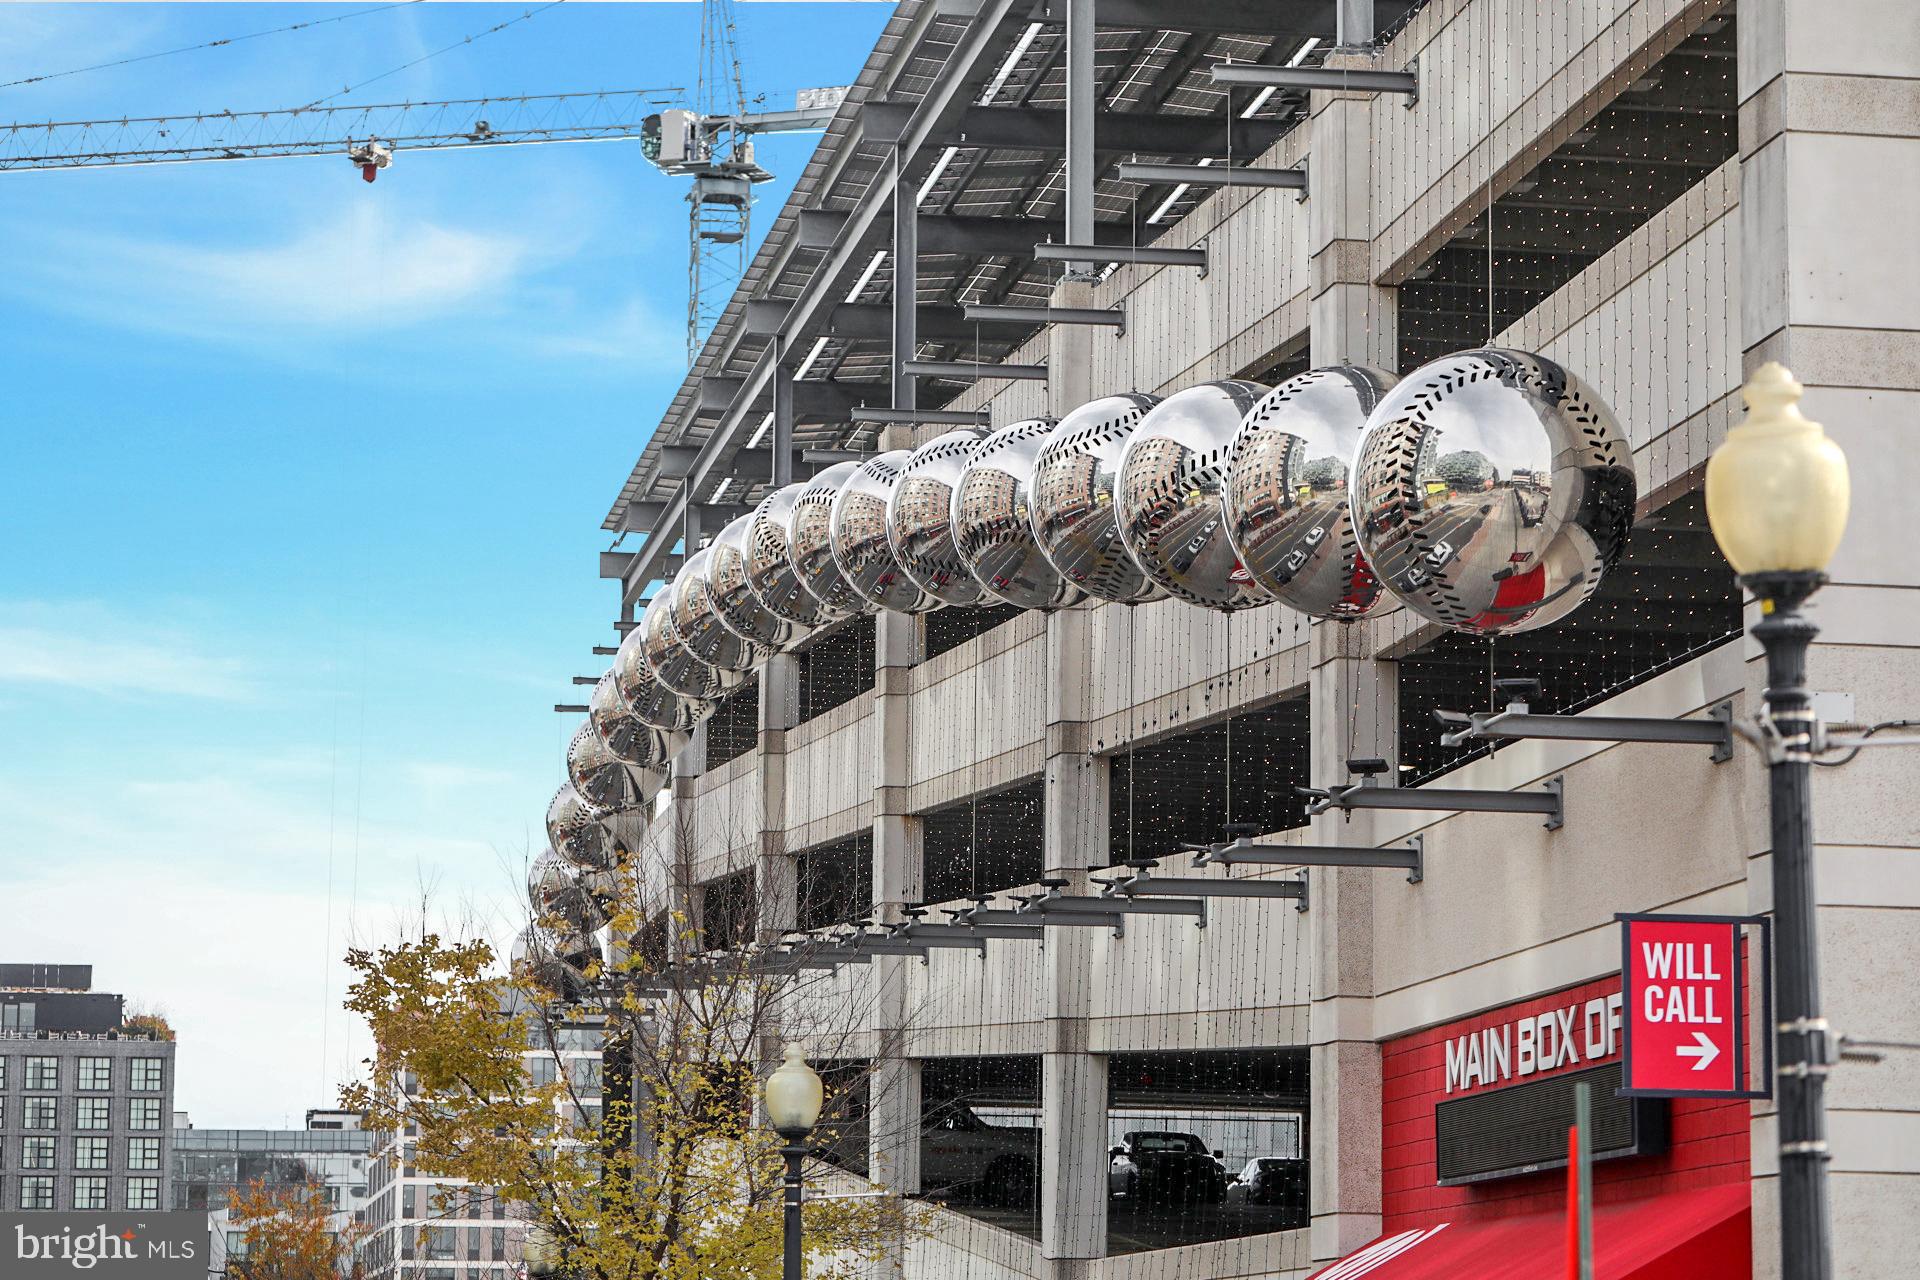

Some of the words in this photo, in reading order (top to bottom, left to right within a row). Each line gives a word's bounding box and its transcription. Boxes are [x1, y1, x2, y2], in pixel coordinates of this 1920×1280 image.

[1643, 942, 1721, 981] WILL
[1644, 985, 1722, 1024] CALL
[1446, 1023, 1511, 1093] MAIN
[1518, 1005, 1579, 1076] BOX
